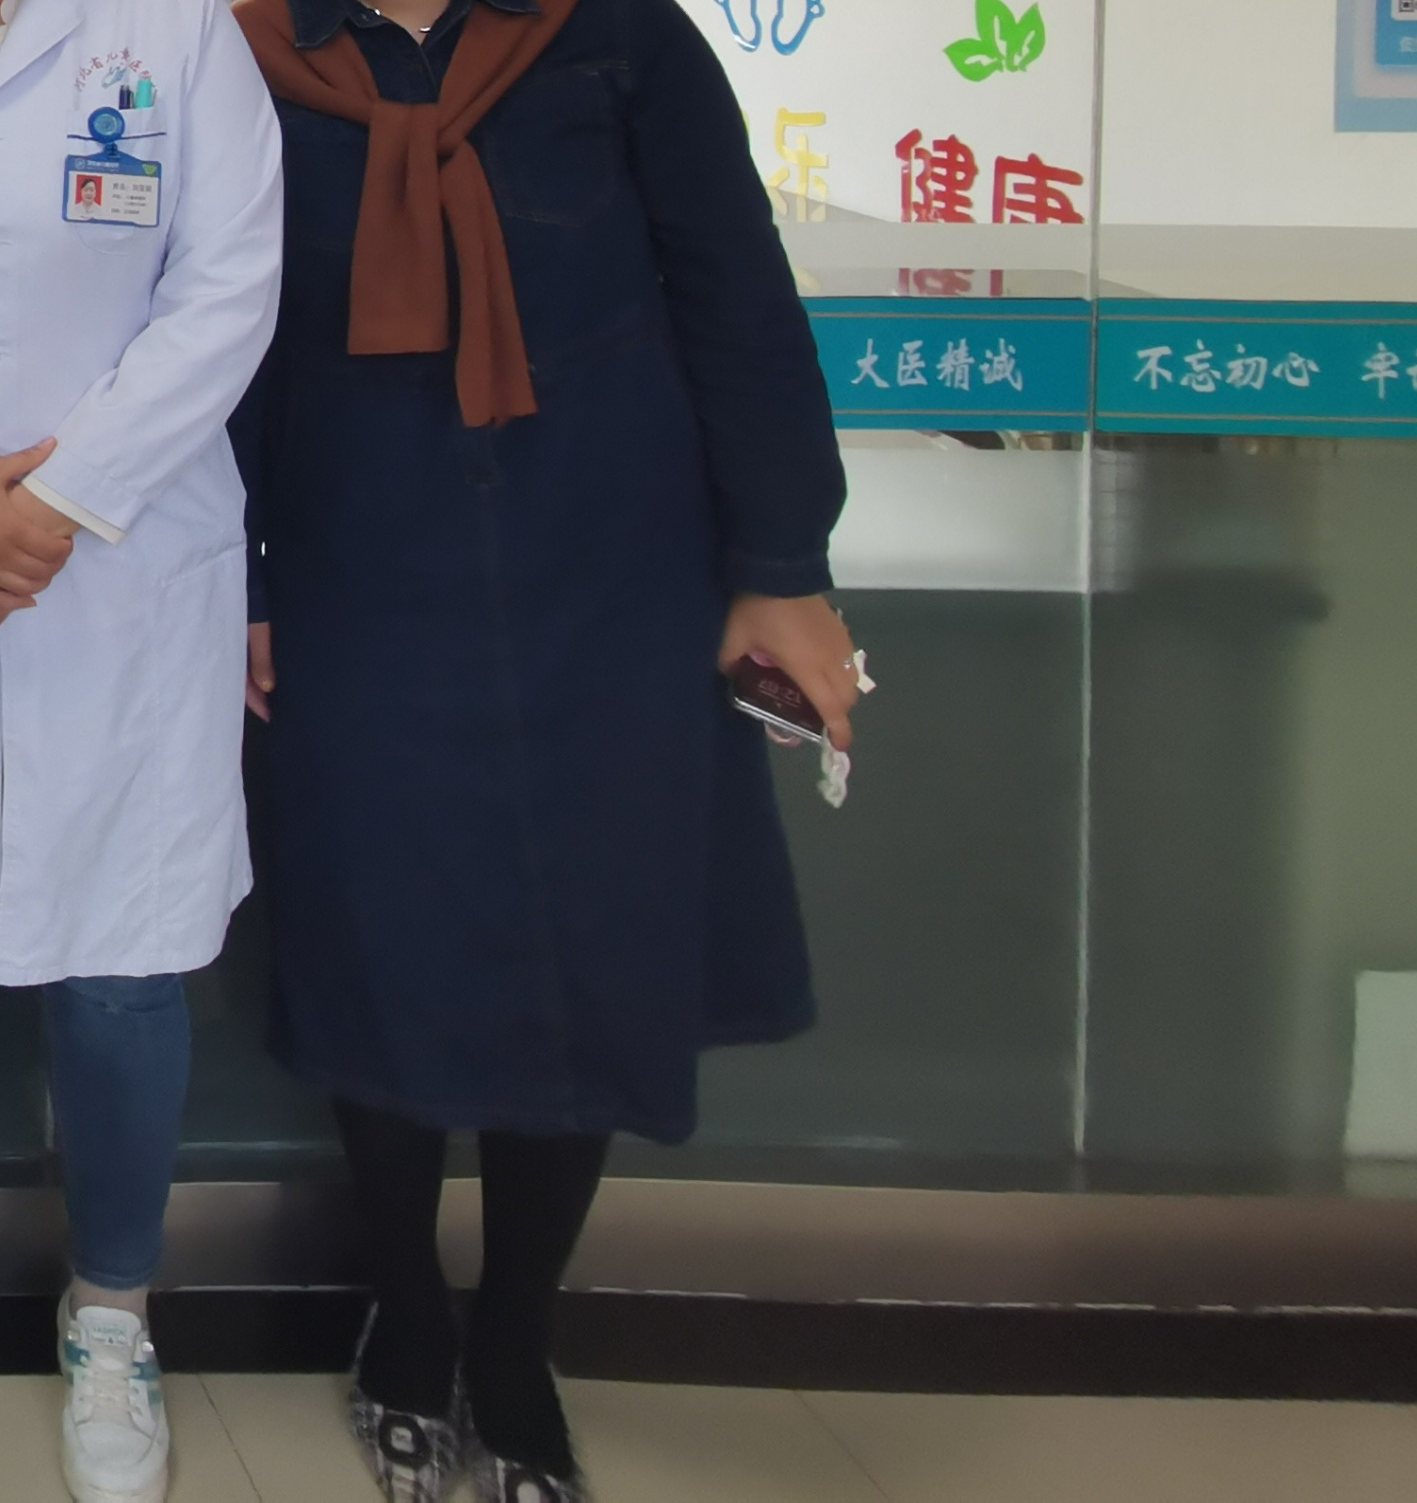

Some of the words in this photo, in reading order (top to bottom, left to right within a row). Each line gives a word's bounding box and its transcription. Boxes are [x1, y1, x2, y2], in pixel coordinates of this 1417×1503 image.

[895, 128, 1084, 224] 健康
[850, 337, 1024, 392] 大医精诚
[1133, 339, 1320, 393] 不忘初心
[1361, 341, 1417, 400] 牢
